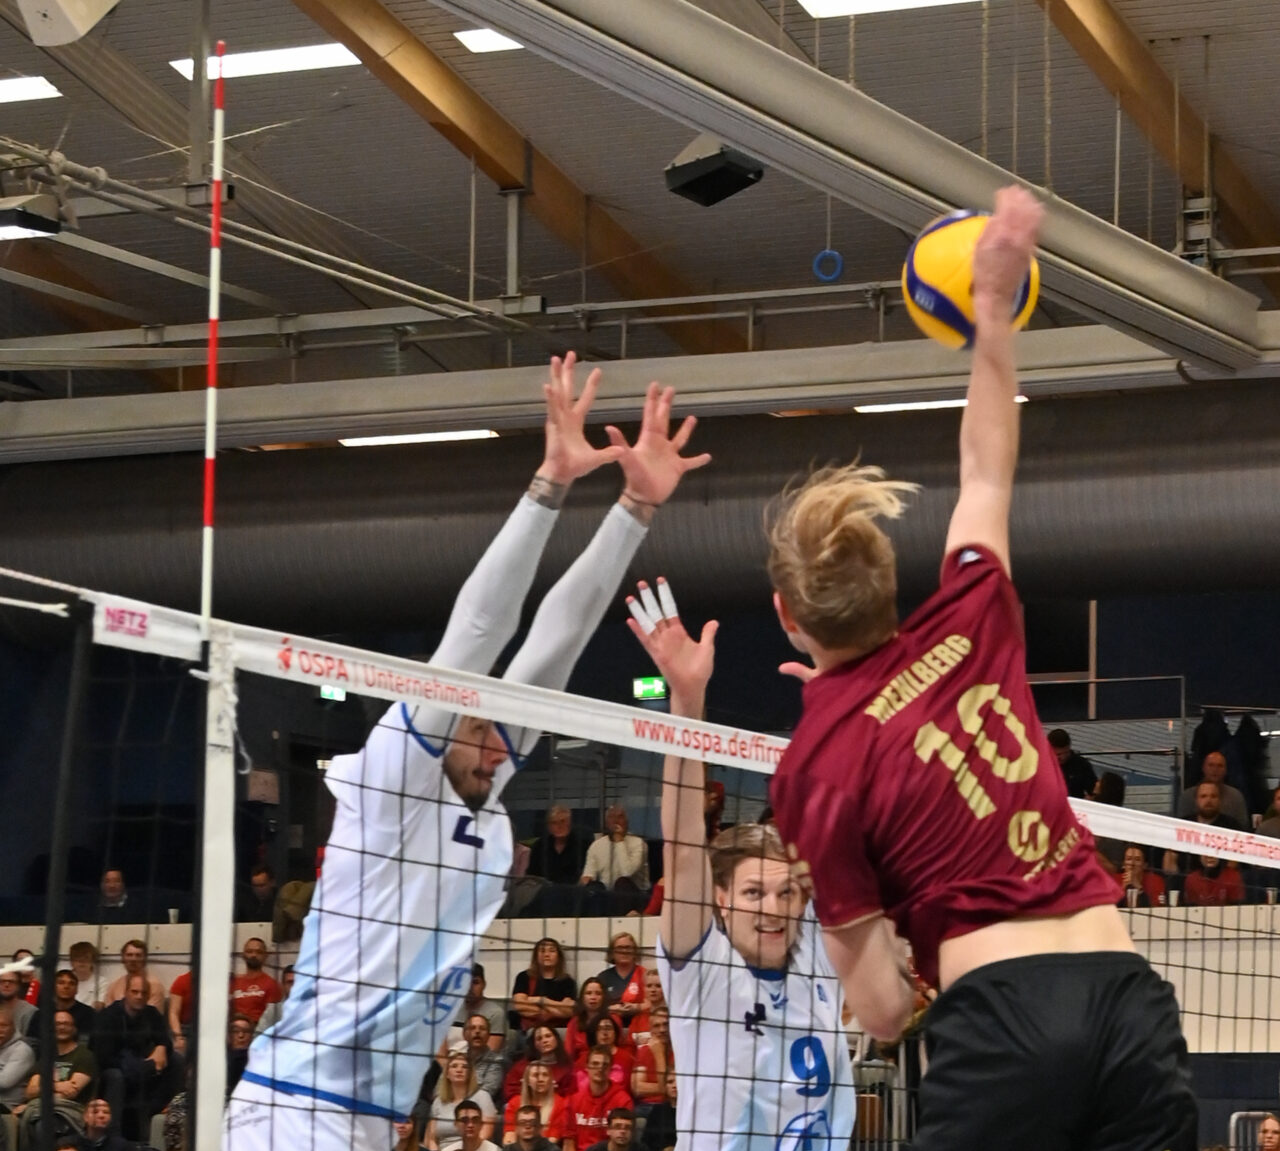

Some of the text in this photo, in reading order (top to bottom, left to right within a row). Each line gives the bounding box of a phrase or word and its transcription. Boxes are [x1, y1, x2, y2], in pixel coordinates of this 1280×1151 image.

[105, 607, 147, 630] NETZ
[298, 650, 480, 708] OSPA Unternehmen
[914, 683, 1039, 820] 10
[790, 1035, 831, 1097] 9
